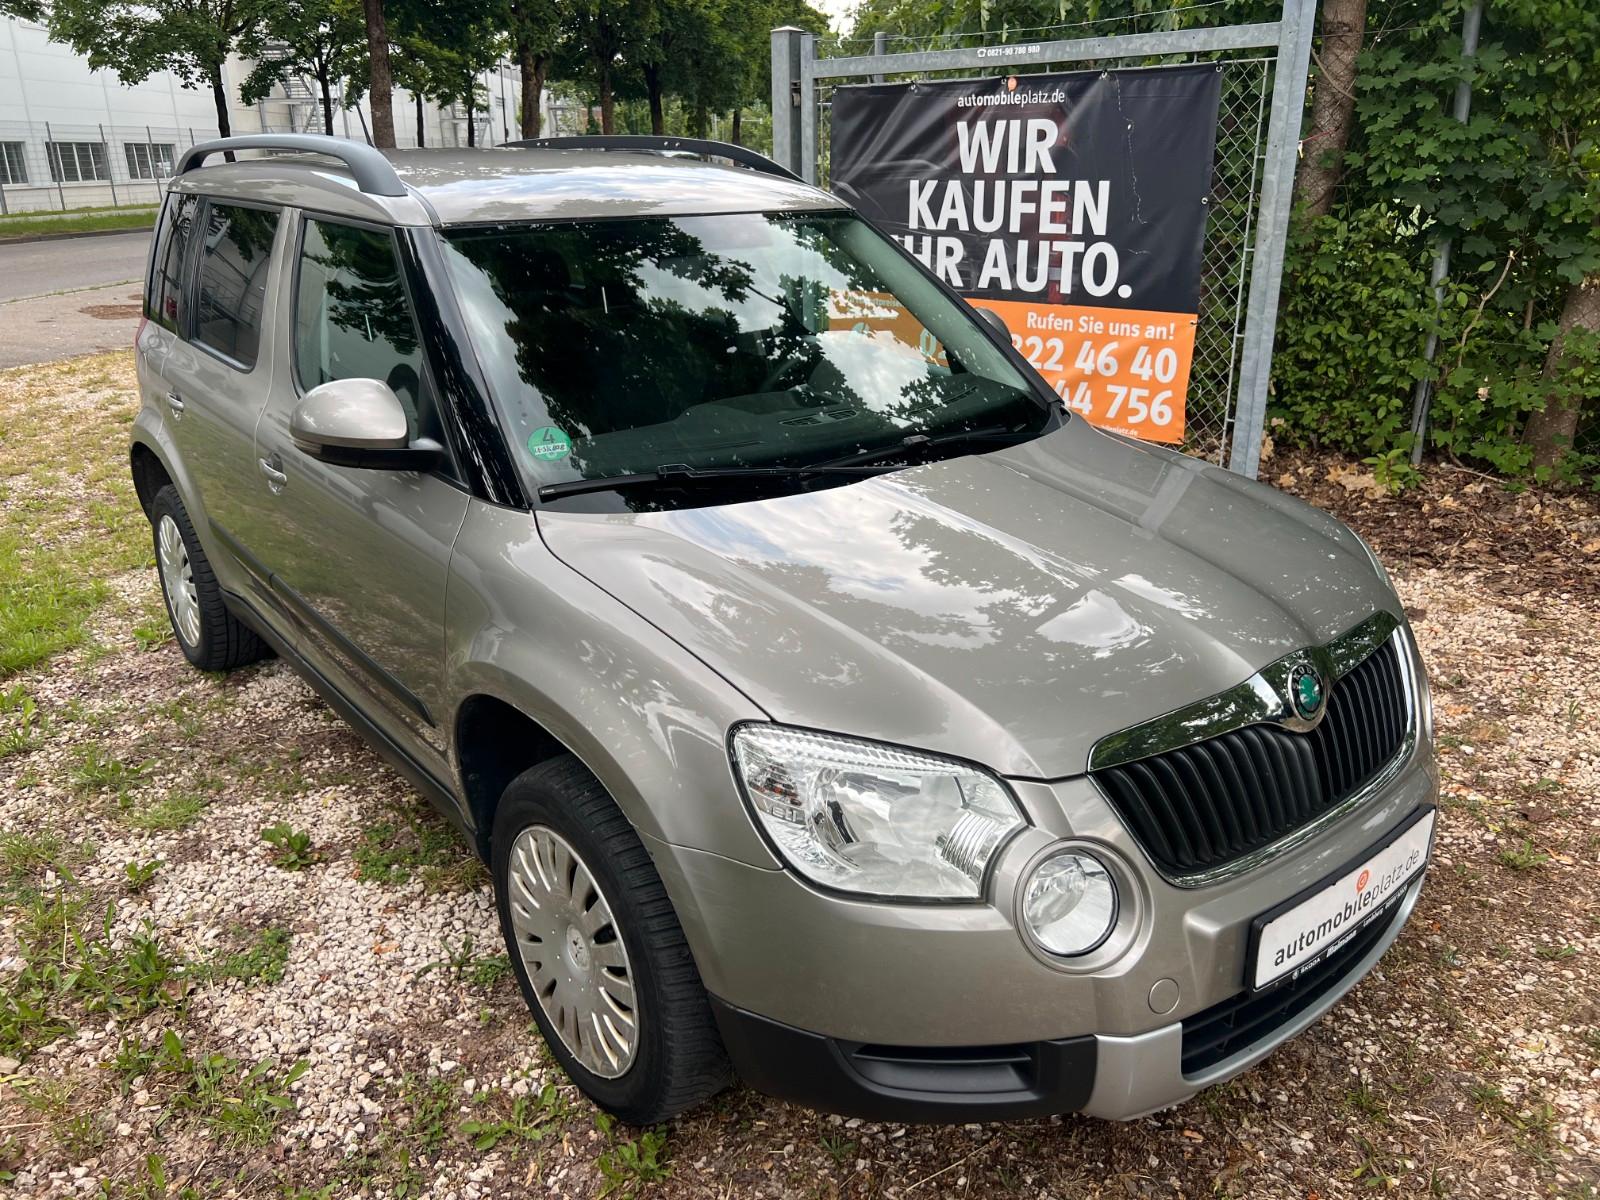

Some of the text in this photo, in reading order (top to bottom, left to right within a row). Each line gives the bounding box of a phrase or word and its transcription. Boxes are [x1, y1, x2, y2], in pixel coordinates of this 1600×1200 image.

[957, 88, 1065, 108] automobileplatz.de
[957, 118, 1058, 174] WIR
[908, 179, 1111, 236] KAUFEN
[890, 234, 1133, 299] HR AUTO.
[1026, 311, 1176, 341] Rufen Sie uns an!
[1074, 340, 1120, 378] 46
[1130, 345, 1178, 384] 40
[1105, 384, 1174, 427] 756
[542, 427, 556, 444] 4
[1274, 848, 1420, 967] automobileplatz.de
